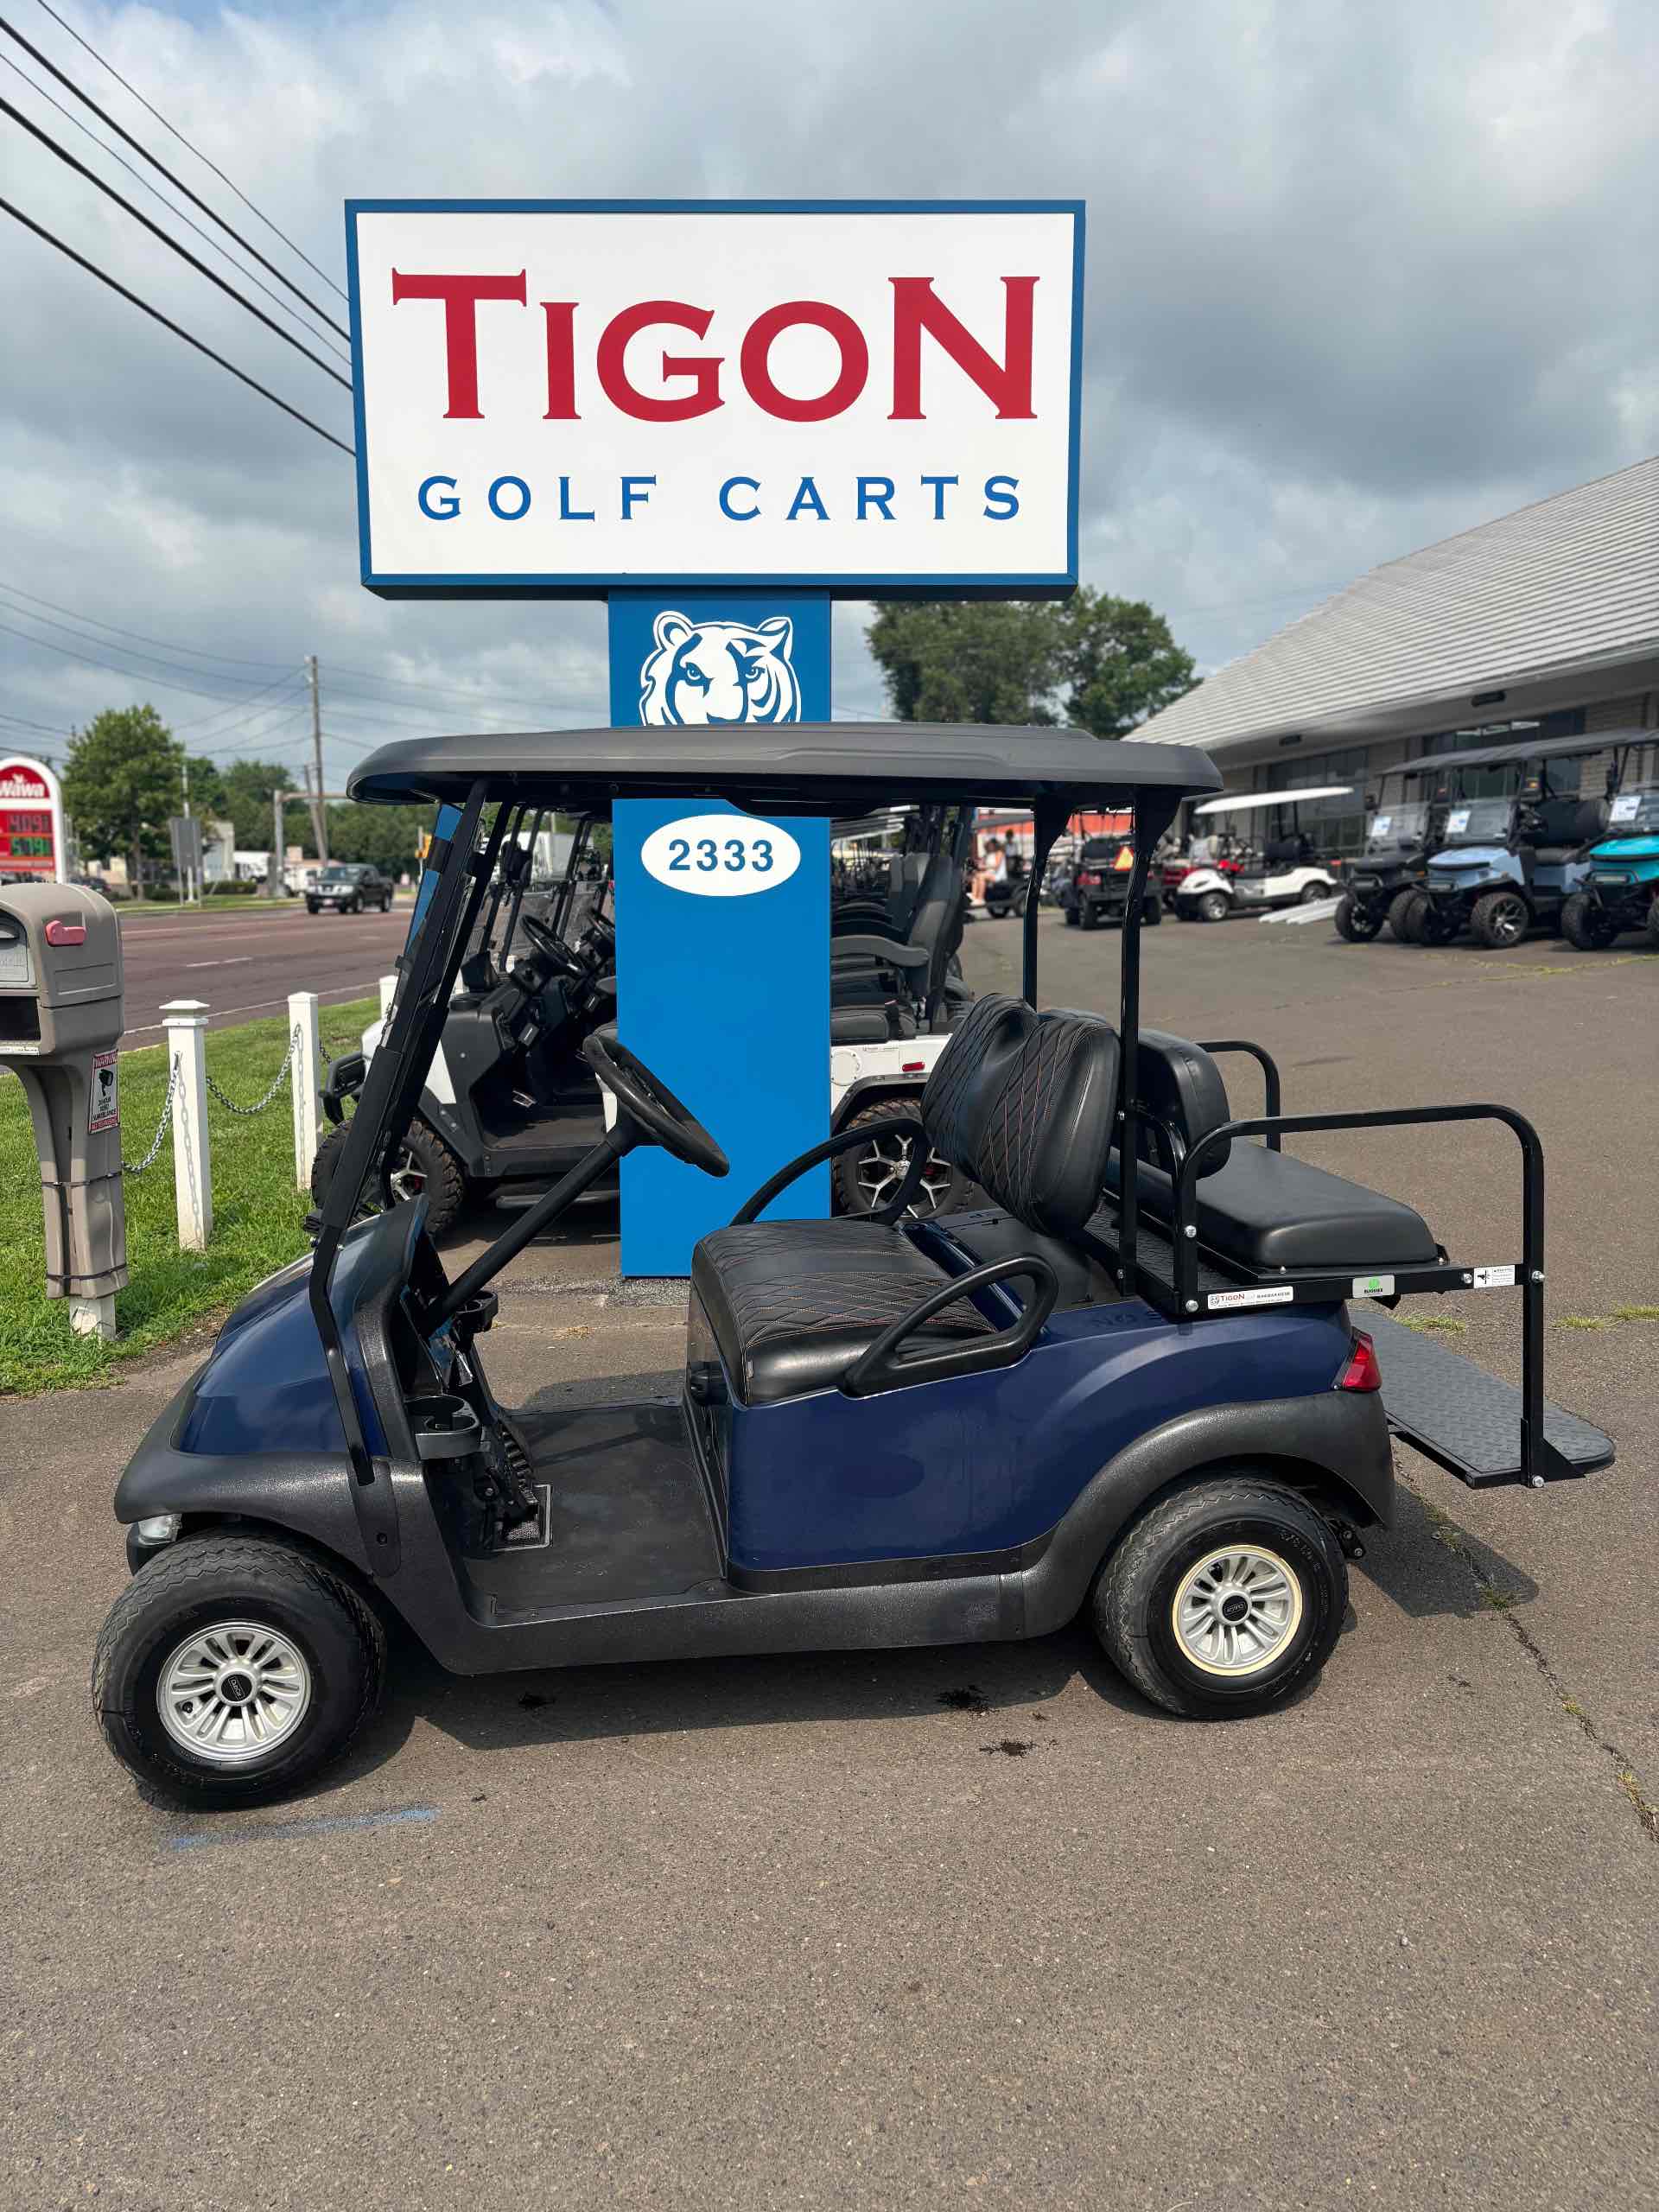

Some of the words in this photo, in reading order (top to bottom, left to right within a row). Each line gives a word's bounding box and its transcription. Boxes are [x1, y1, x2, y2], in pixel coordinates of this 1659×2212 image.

[391, 268, 1039, 423] TIGON
[418, 475, 657, 521] GOLF
[719, 475, 1020, 521] CARTS
[668, 839, 773, 872] 2333
